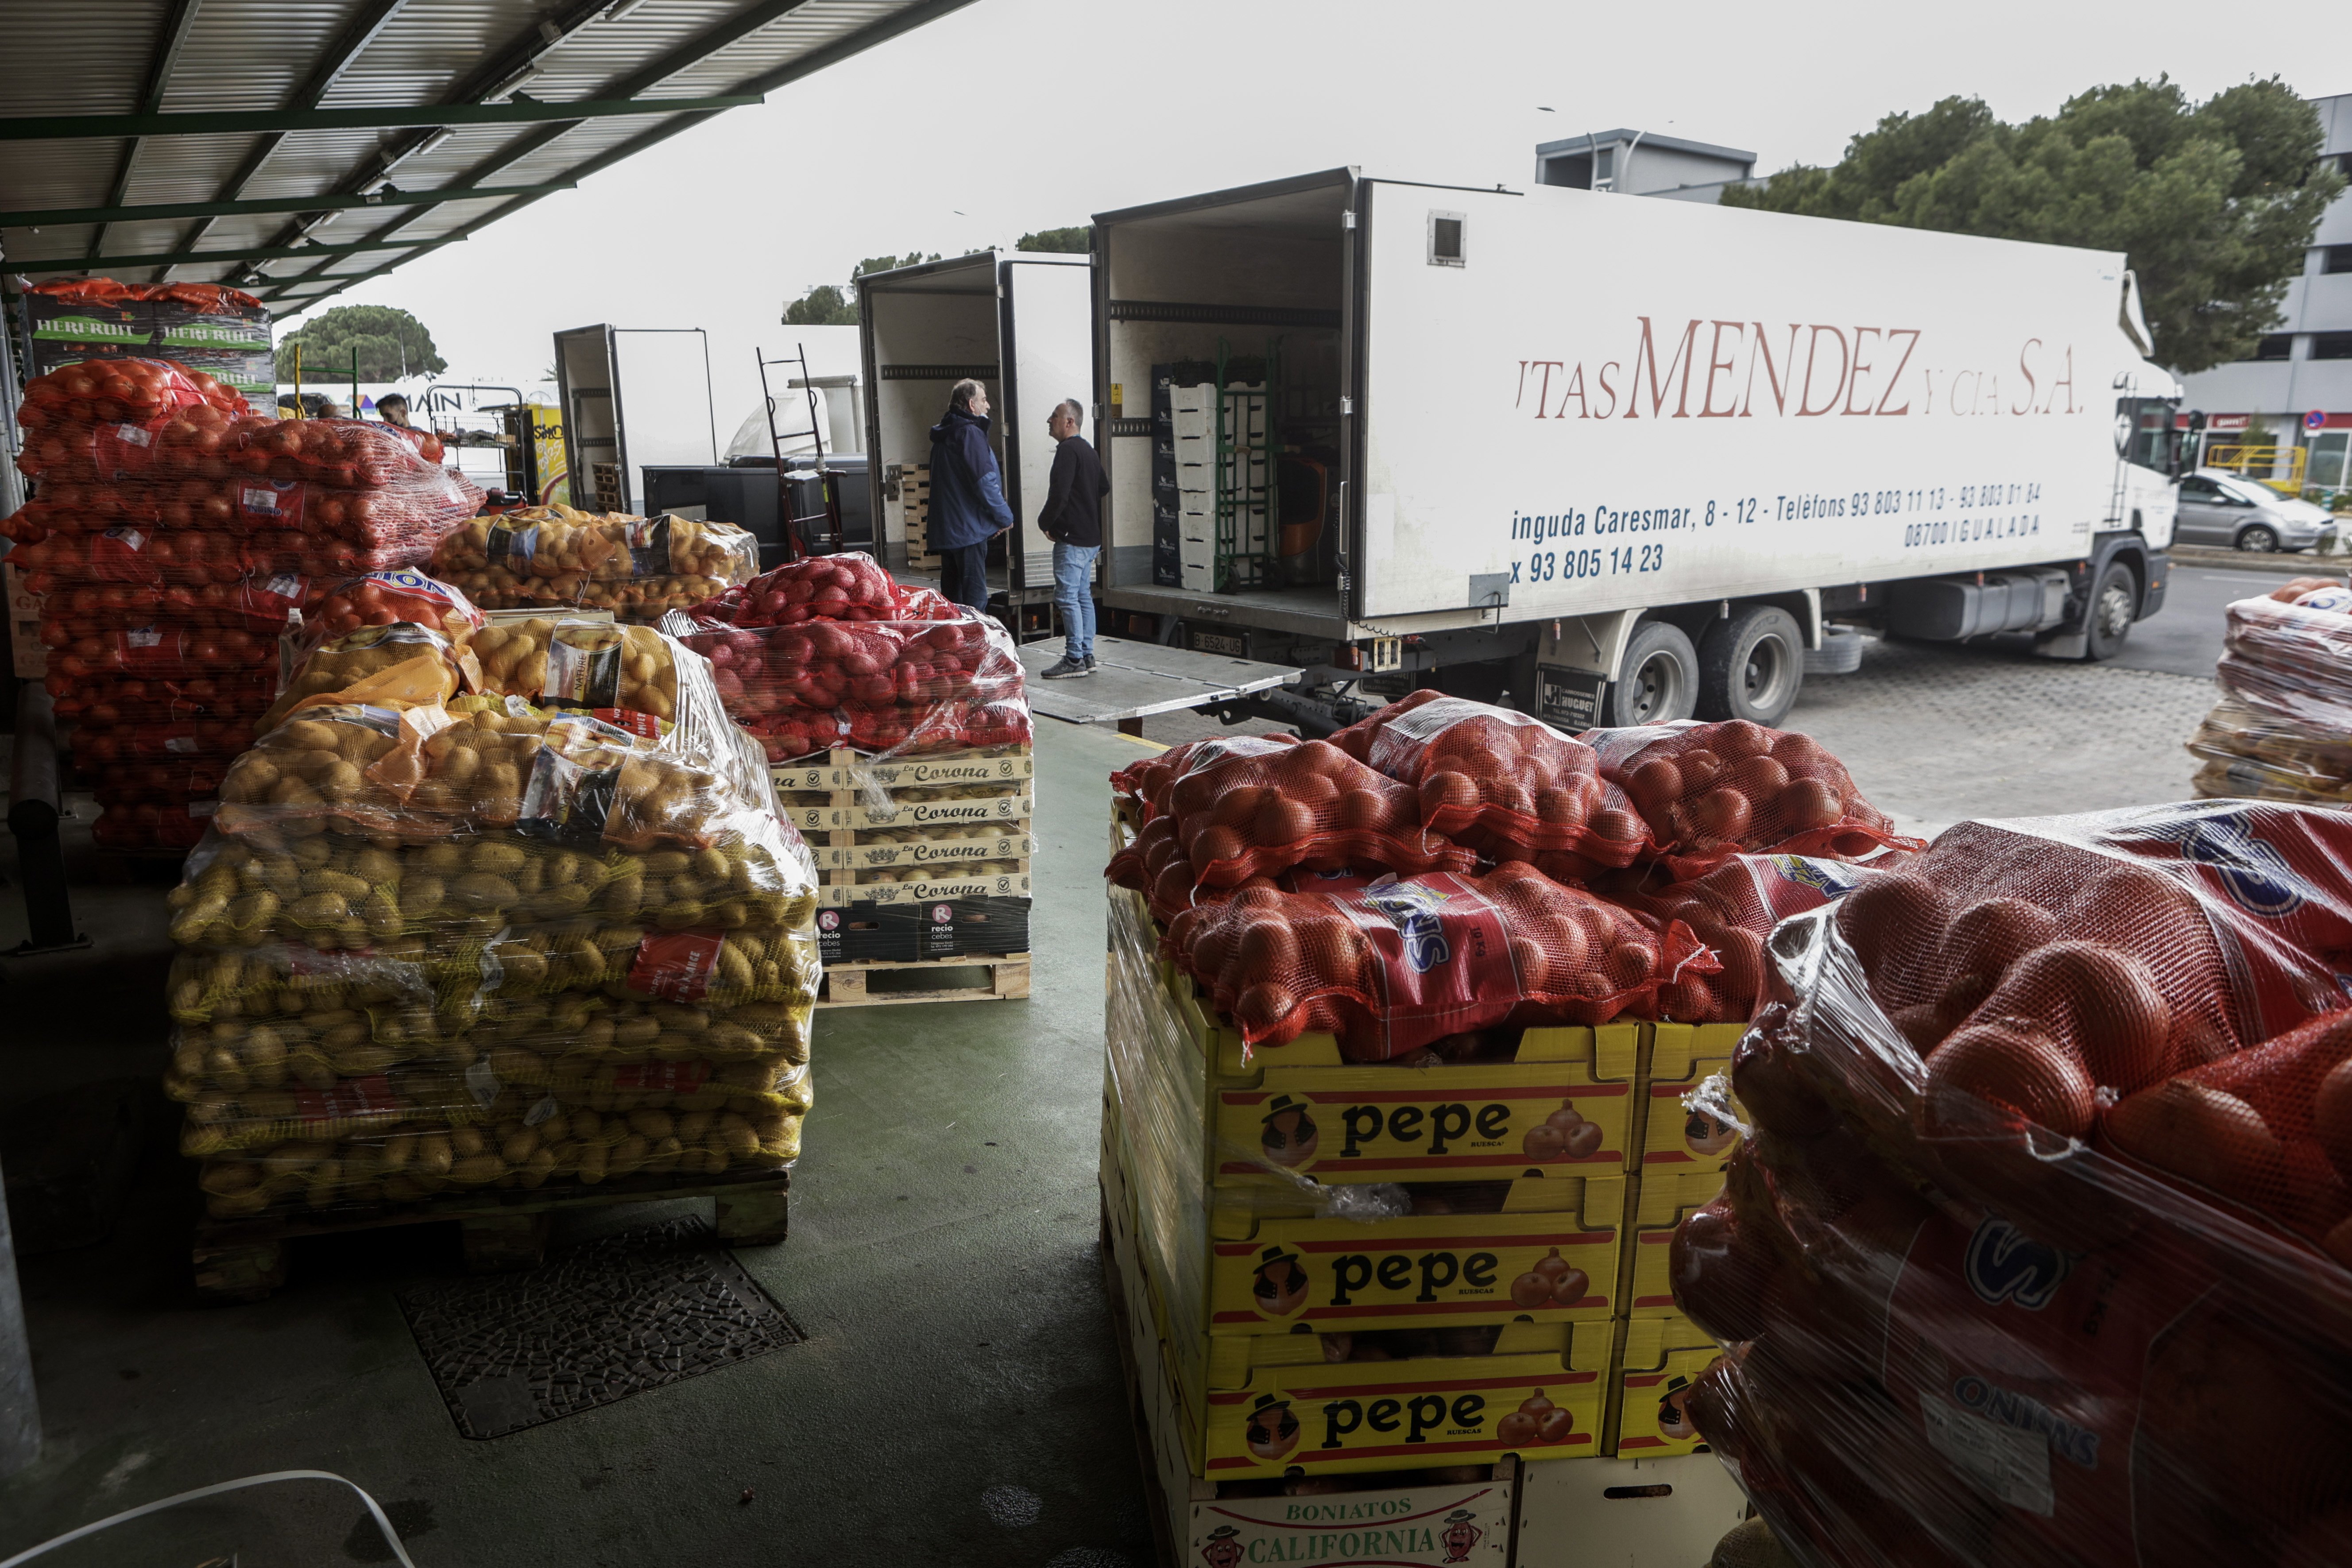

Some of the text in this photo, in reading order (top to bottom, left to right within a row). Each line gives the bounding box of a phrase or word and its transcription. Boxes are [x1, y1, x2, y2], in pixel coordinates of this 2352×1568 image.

[36, 319, 134, 337] HERFRUIT
[1623, 316, 1922, 420] MENDEZ
[2012, 338, 2083, 416] S.A.
[1594, 505, 1696, 534] Caresmar,
[1705, 500, 1715, 527] 8
[1737, 498, 1756, 523] 12
[1777, 494, 1845, 521] Telèfons
[1851, 492, 1869, 517] 93
[1874, 490, 1901, 515] 803
[1907, 489, 1923, 512] 11
[1930, 488, 1944, 510] 13
[1904, 514, 2040, 547] 08700 IGUALADA
[1530, 552, 1555, 582] 93
[1563, 549, 1601, 579] 805
[1611, 546, 1632, 574] 14
[1640, 544, 1663, 572] 23
[575, 655, 587, 691] NATURE
[1562, 696, 1594, 712] HUGUET
[915, 765, 990, 782] Corona
[914, 805, 988, 821] Corona
[914, 845, 988, 861] Corona
[914, 883, 987, 899] Corona
[823, 914, 838, 927] R
[936, 907, 951, 921] R
[1340, 1103, 1511, 1157] pepe
[1330, 1252, 1498, 1306] pepe
[1321, 1394, 1485, 1449] pepe
[1953, 1374, 2102, 1471] ONIONS
[1286, 1498, 1412, 1522] BONIATOS
[1248, 1527, 1435, 1564] CALIFORNIA
